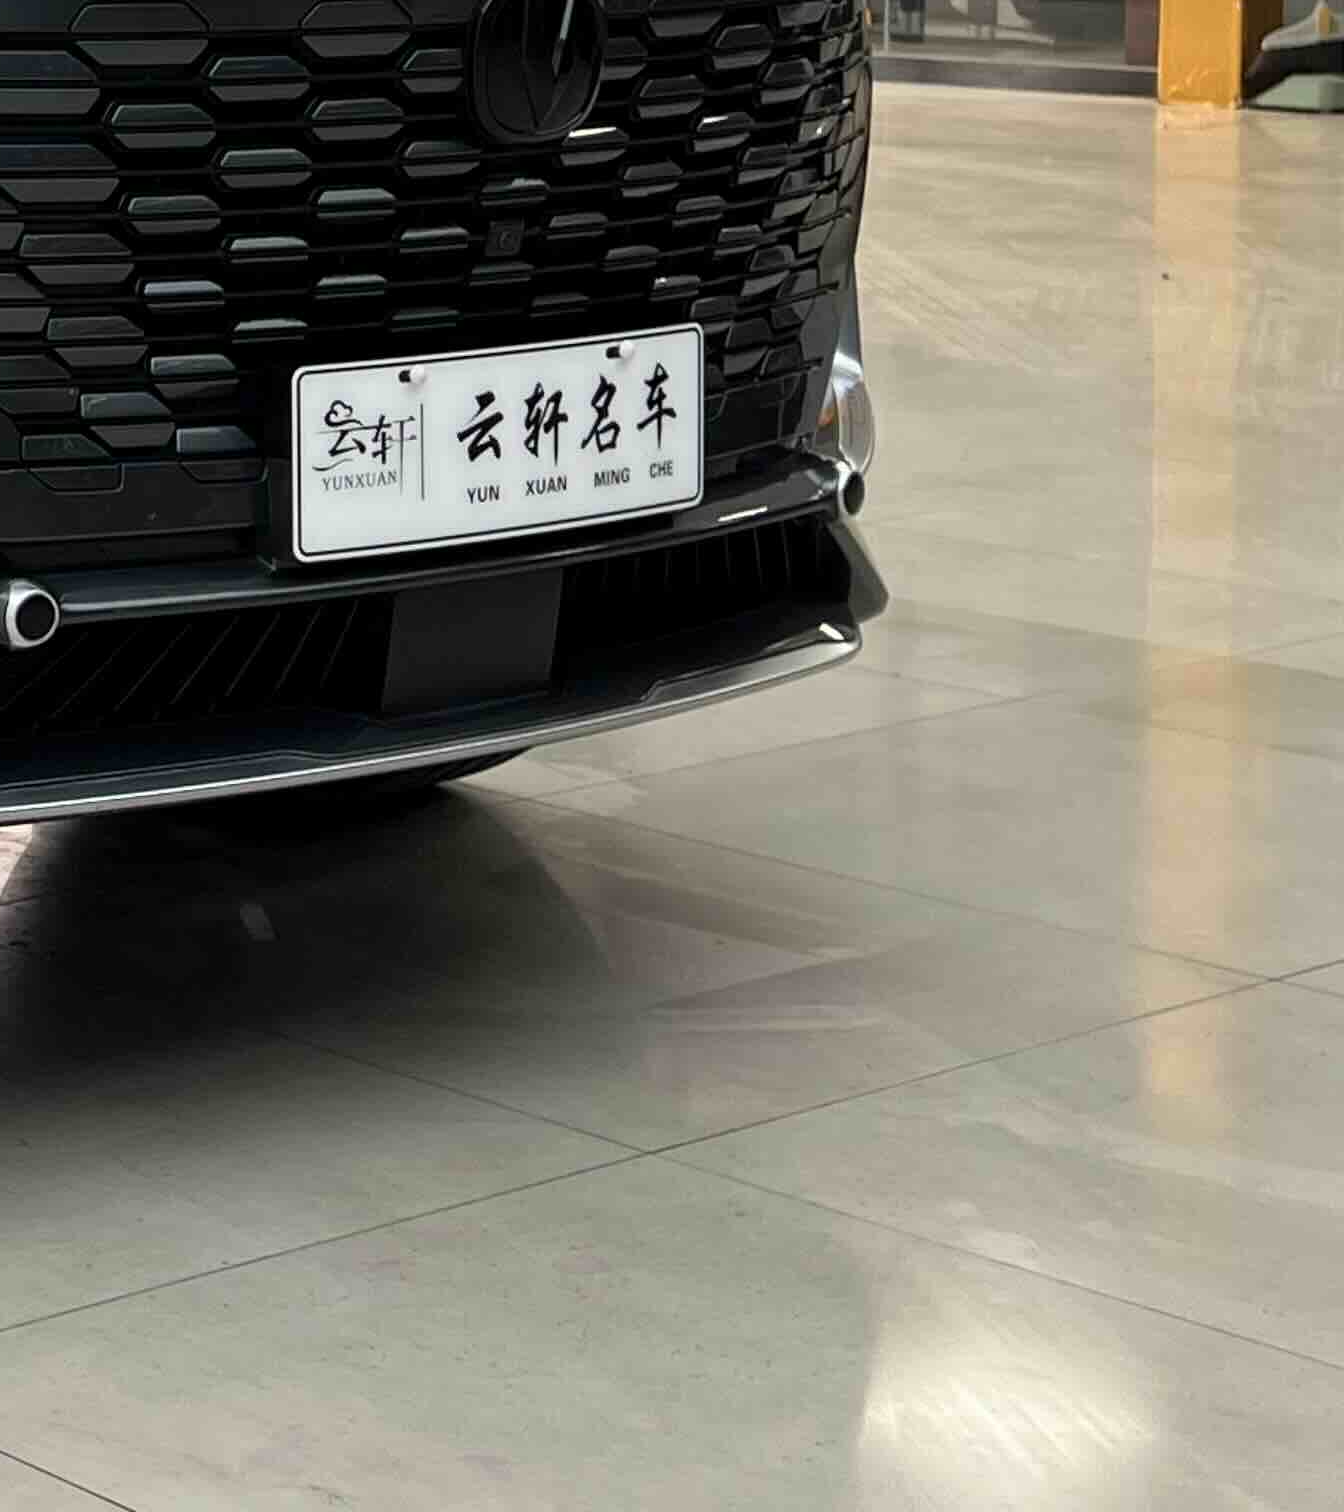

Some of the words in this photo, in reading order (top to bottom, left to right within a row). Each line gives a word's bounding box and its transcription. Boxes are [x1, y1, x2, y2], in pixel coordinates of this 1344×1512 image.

[322, 470, 398, 492] YUNXUAN
[467, 485, 500, 504] YUN
[525, 475, 568, 496] XUAN
[594, 467, 631, 488] MING
[649, 460, 673, 478] CHE
